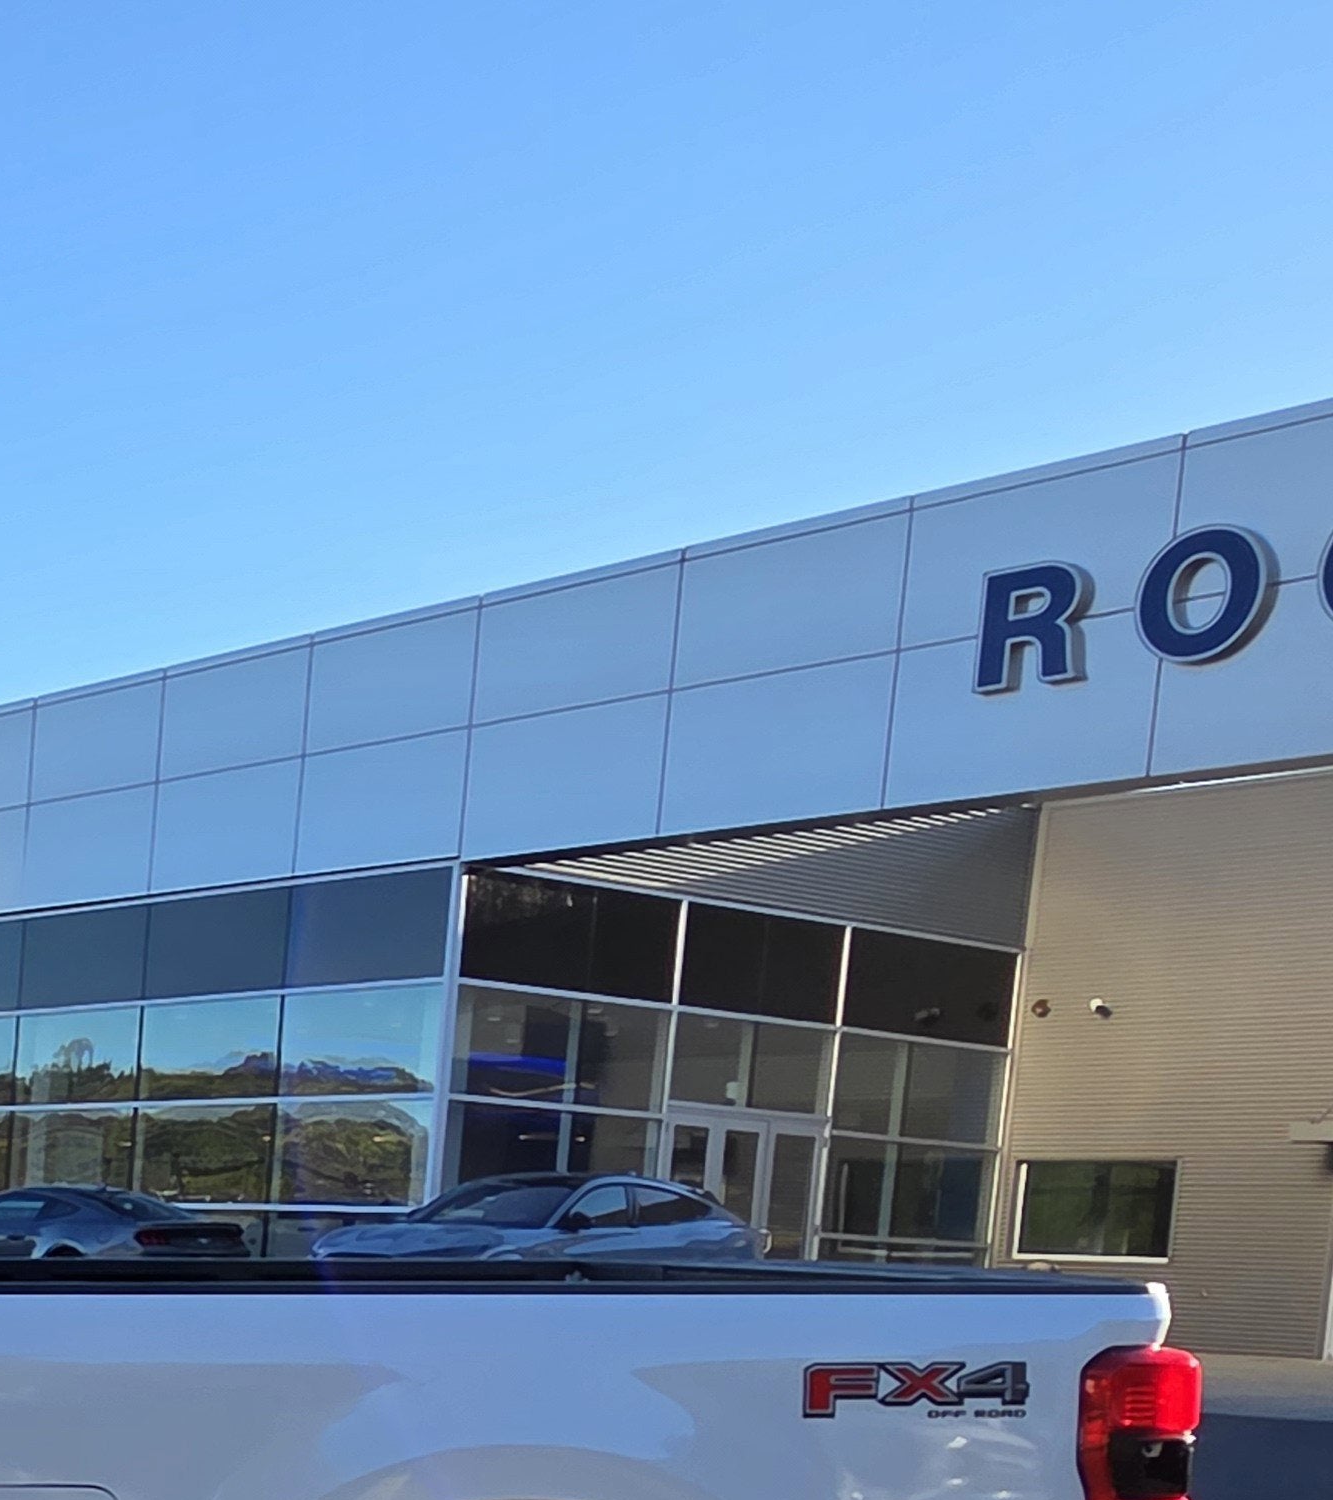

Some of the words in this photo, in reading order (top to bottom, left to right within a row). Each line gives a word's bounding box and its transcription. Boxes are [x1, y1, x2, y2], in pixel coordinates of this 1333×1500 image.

[973, 523, 1333, 696] RO
[803, 1361, 1030, 1418] FX4
[927, 1409, 967, 1419] OFF
[974, 1408, 1027, 1419] ROAD
